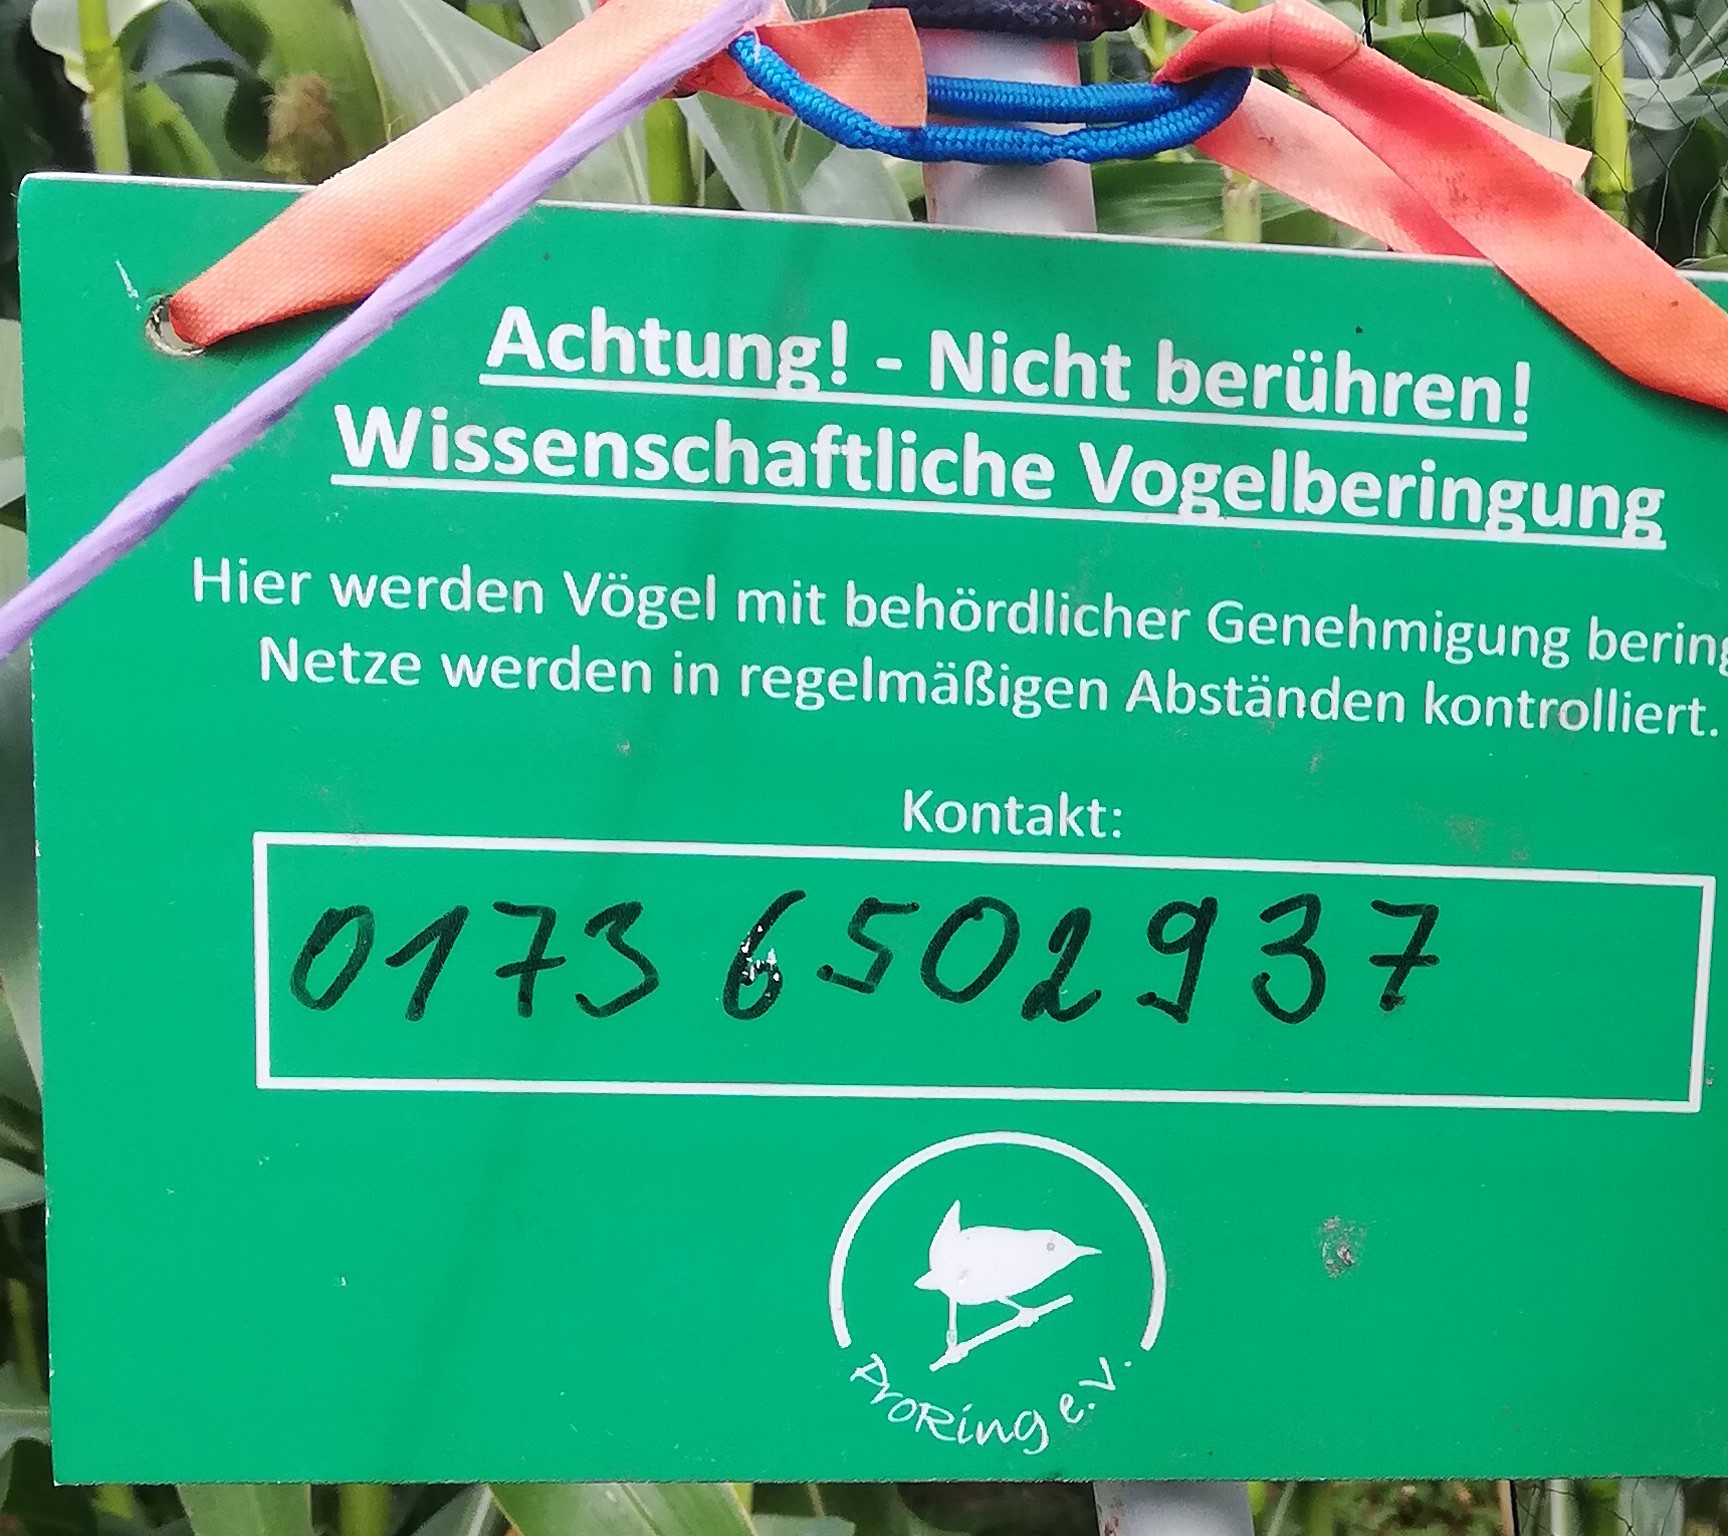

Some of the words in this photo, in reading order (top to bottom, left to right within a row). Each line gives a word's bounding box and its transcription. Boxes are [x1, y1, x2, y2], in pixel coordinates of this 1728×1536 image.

[486, 305, 848, 395] Achtung!
[930, 328, 1131, 403] Nicht
[1157, 337, 1530, 424] berühren!
[334, 404, 1055, 503] Wissenschaftliche
[1079, 441, 1665, 543] Vogelberingung
[192, 556, 311, 607] Hier
[330, 564, 544, 616] werden
[563, 571, 715, 630] Vögel
[738, 577, 824, 627] mit
[846, 581, 1190, 643] behördlicher
[1207, 599, 1570, 669] Genehmigung
[260, 636, 422, 688] Netze
[441, 643, 652, 696] werden
[674, 652, 718, 696] in
[740, 658, 1108, 718] regelmäßigen
[1126, 671, 1405, 726] Abständen
[1426, 680, 1720, 739] kontrolliert.
[903, 789, 1122, 839] Kontakt:
[290, 900, 660, 1021] 0173
[722, 890, 1440, 1024] 6502937
[850, 1353, 1050, 1455] ProRing
[1060, 1356, 1132, 1424] e.V.
